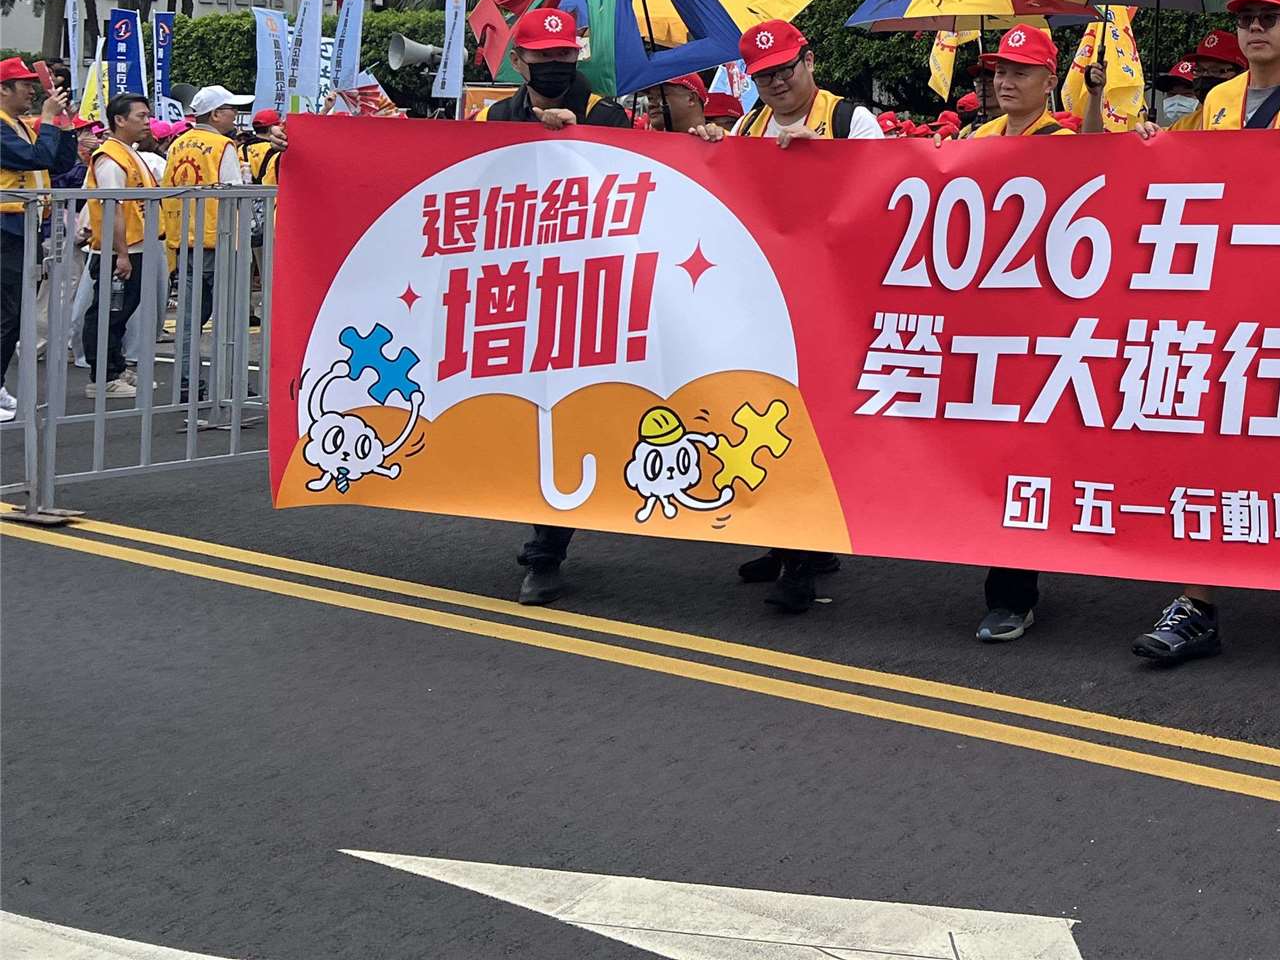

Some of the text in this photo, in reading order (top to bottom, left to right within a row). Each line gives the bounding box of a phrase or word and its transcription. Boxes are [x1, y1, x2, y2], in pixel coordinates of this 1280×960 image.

[421, 171, 657, 257] 退休給付
[882, 174, 1113, 299] 2026
[437, 251, 660, 381] 增加!
